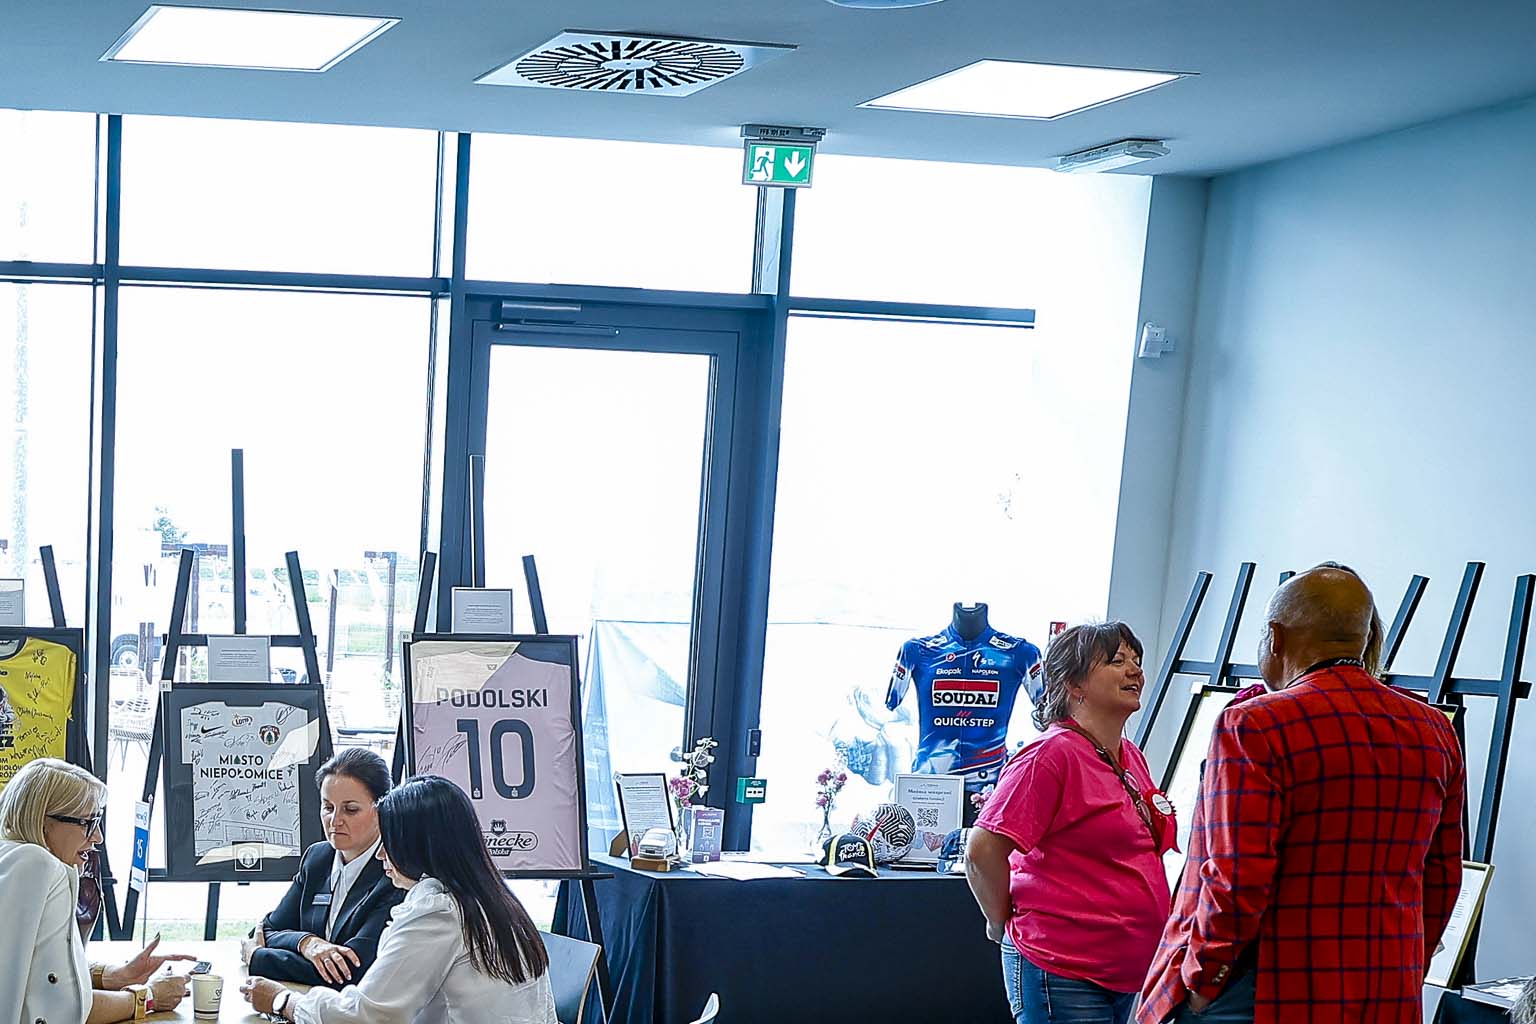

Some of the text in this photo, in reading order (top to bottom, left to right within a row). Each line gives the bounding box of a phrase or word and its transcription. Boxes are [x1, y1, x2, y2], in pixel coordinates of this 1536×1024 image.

[436, 688, 548, 708] PODOLSKI
[934, 692, 997, 705] SOUDAL
[456, 718, 536, 799] 10
